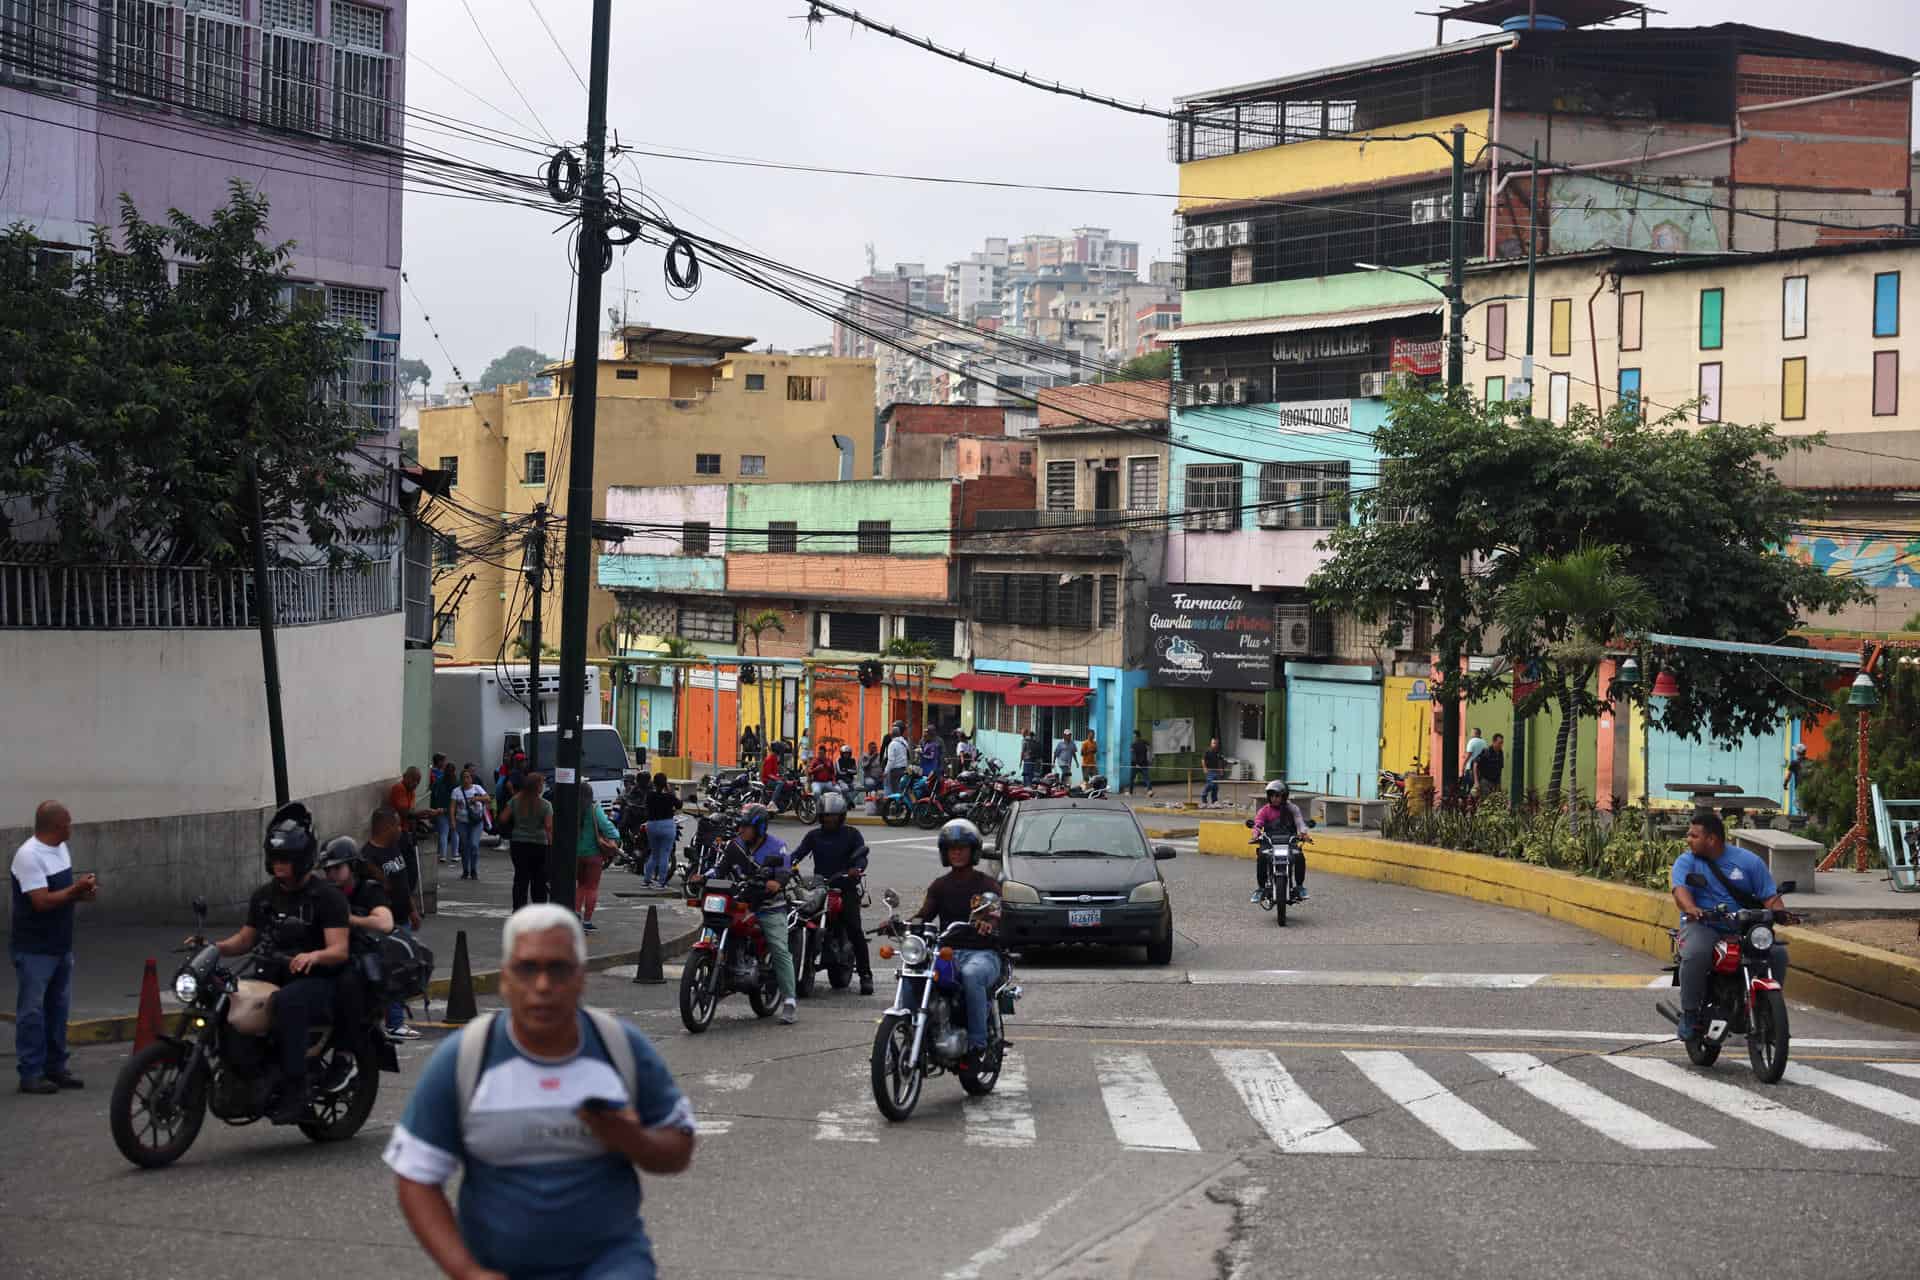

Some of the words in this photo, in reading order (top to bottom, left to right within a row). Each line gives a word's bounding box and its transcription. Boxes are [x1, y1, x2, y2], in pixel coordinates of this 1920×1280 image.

[1280, 402, 1349, 426] ODONTOLOGÍA
[1171, 593, 1244, 610] Farmacia
[1239, 634, 1261, 648] Plus
